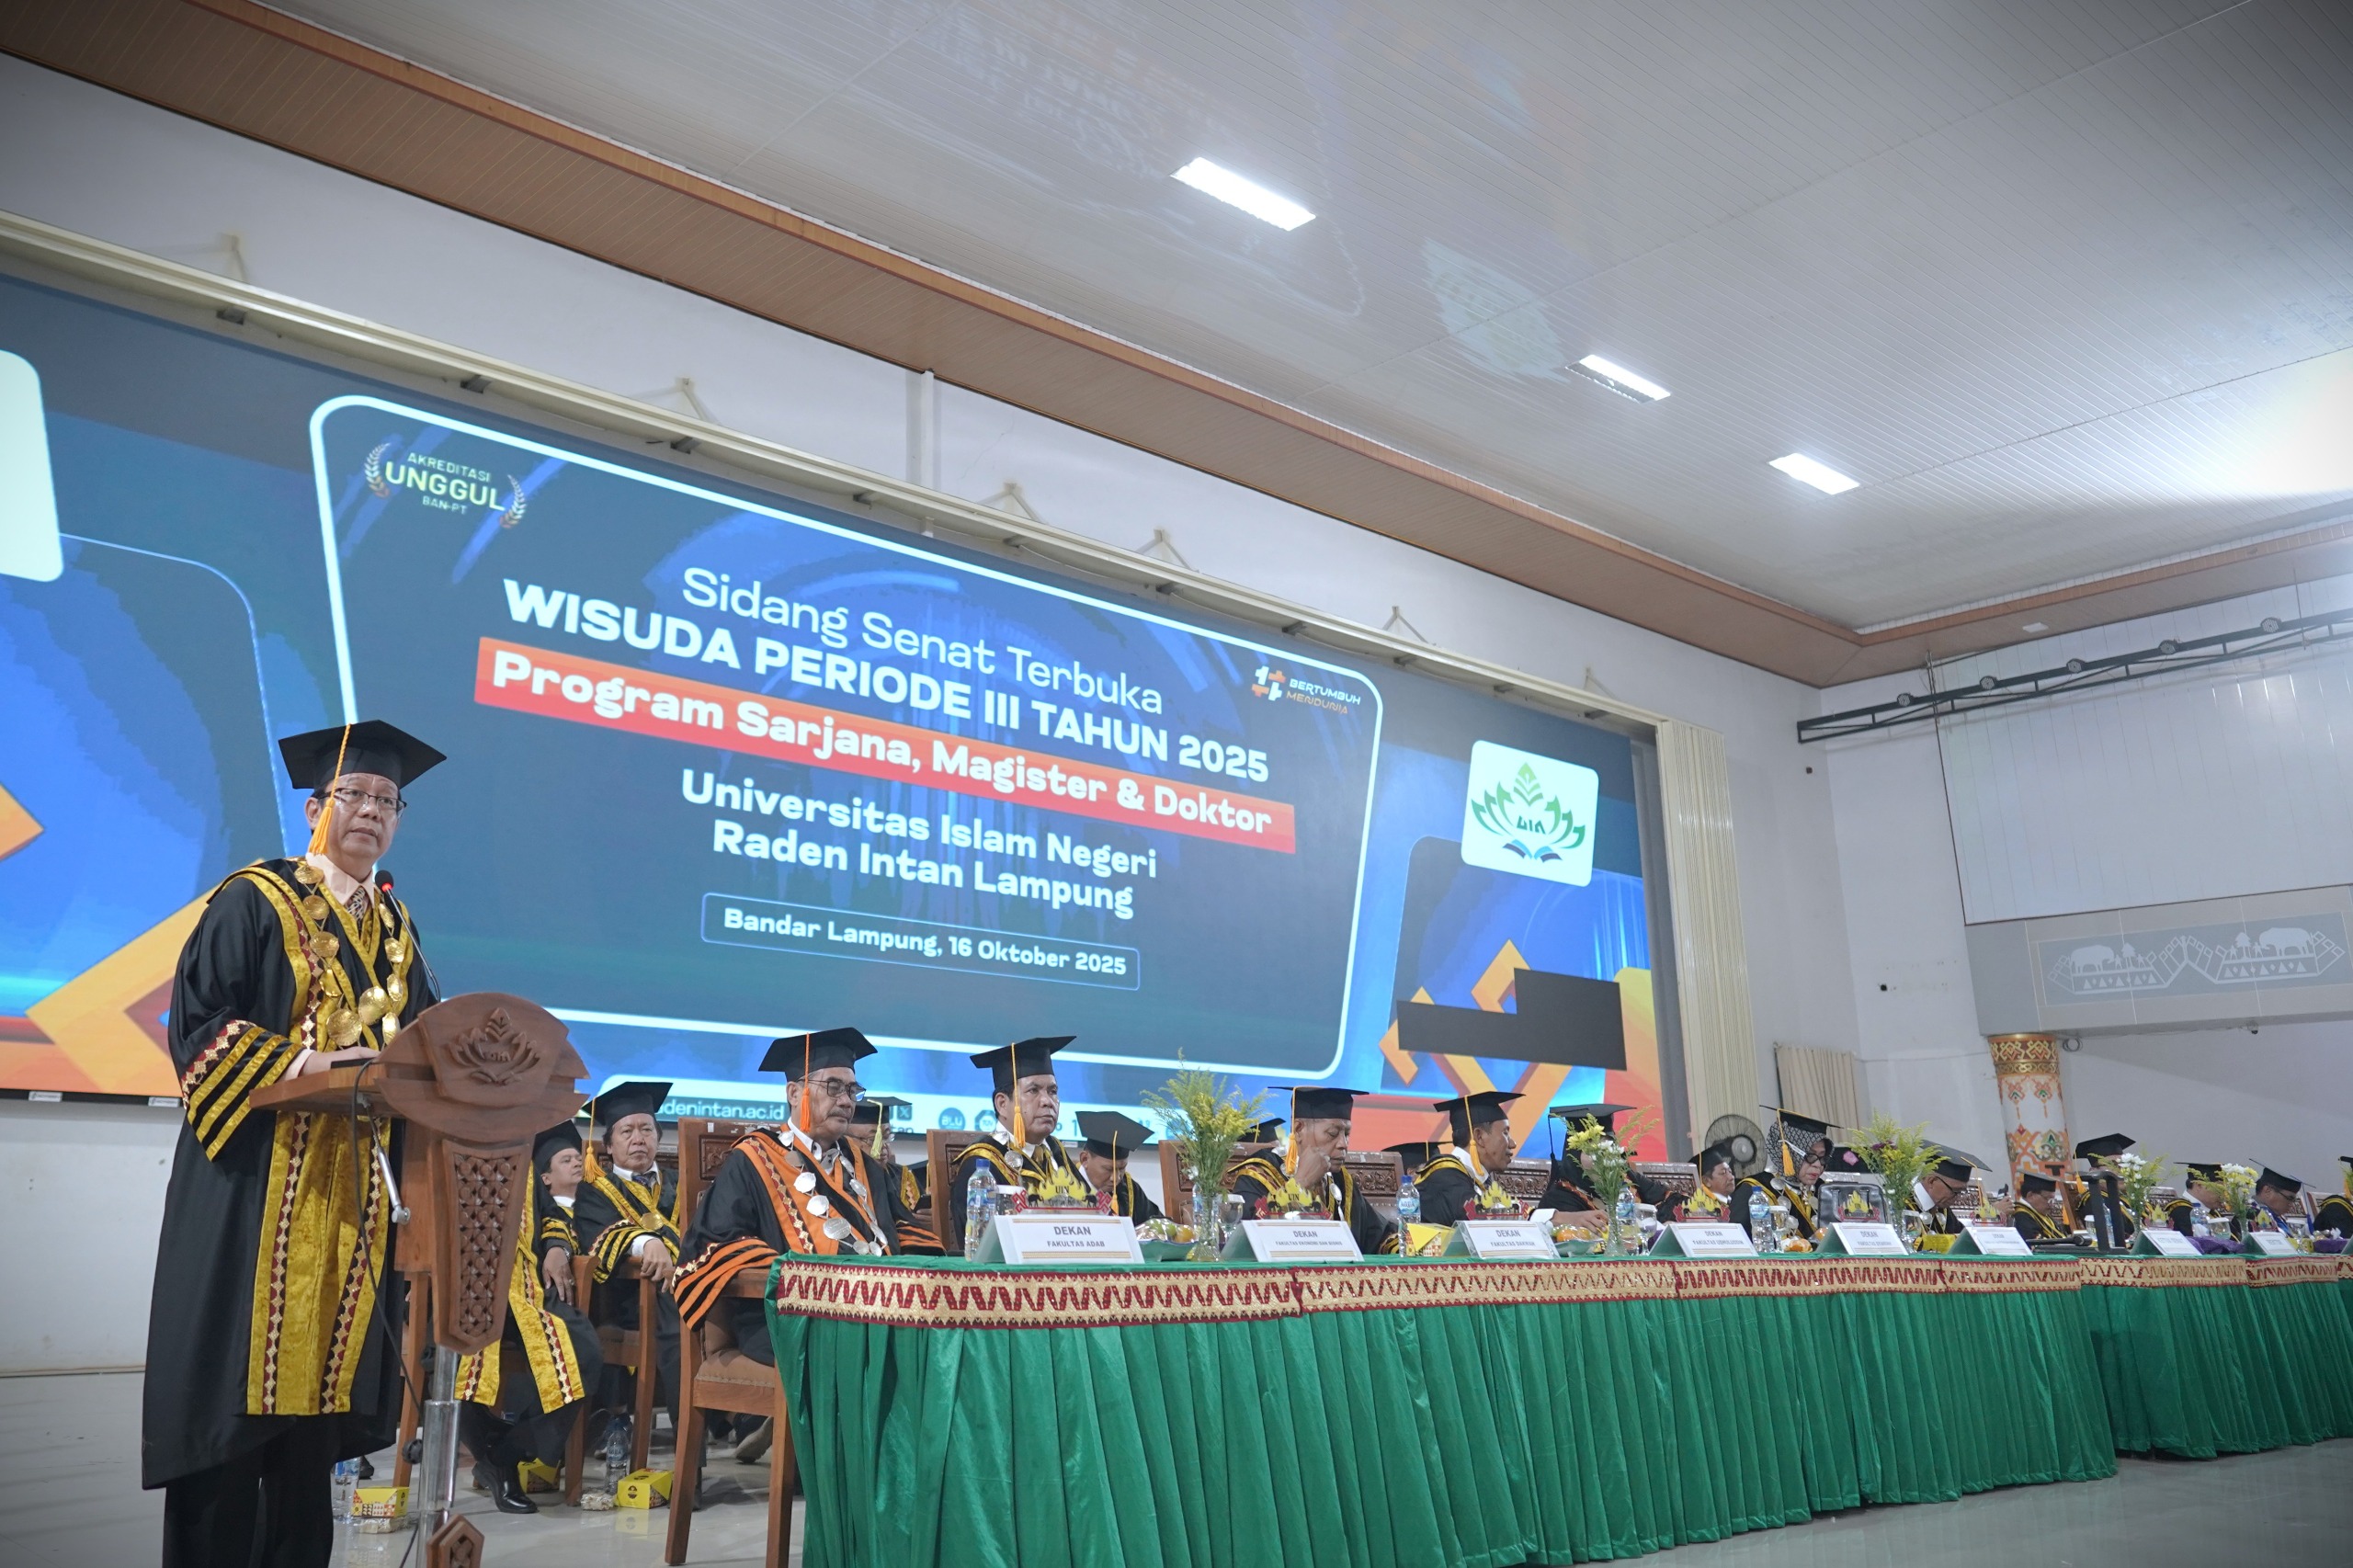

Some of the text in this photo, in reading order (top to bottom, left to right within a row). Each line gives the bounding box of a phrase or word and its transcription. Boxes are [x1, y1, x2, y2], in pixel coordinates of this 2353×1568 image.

[385, 461, 506, 511] UNGGUL
[407, 452, 491, 483] AKREDITASI
[422, 495, 468, 515] BAN-PT
[684, 567, 1162, 715] Sidang Senat Terbuka
[504, 579, 1269, 783] WISUDA PERIODE III TAHUN 2025
[1286, 691, 1348, 714] MENDUNIA
[1289, 678, 1361, 705] BERTUMBUH
[493, 651, 1272, 834] Program Sarjana, Magister & Doktor
[682, 769, 1156, 878] Universitas Islam Negeri
[713, 820, 1133, 920] Raden Intan Lampung
[724, 908, 1127, 975] Bandar Lampung, 16 Oktober 2025
[1053, 1226, 1092, 1235] DEKAN
